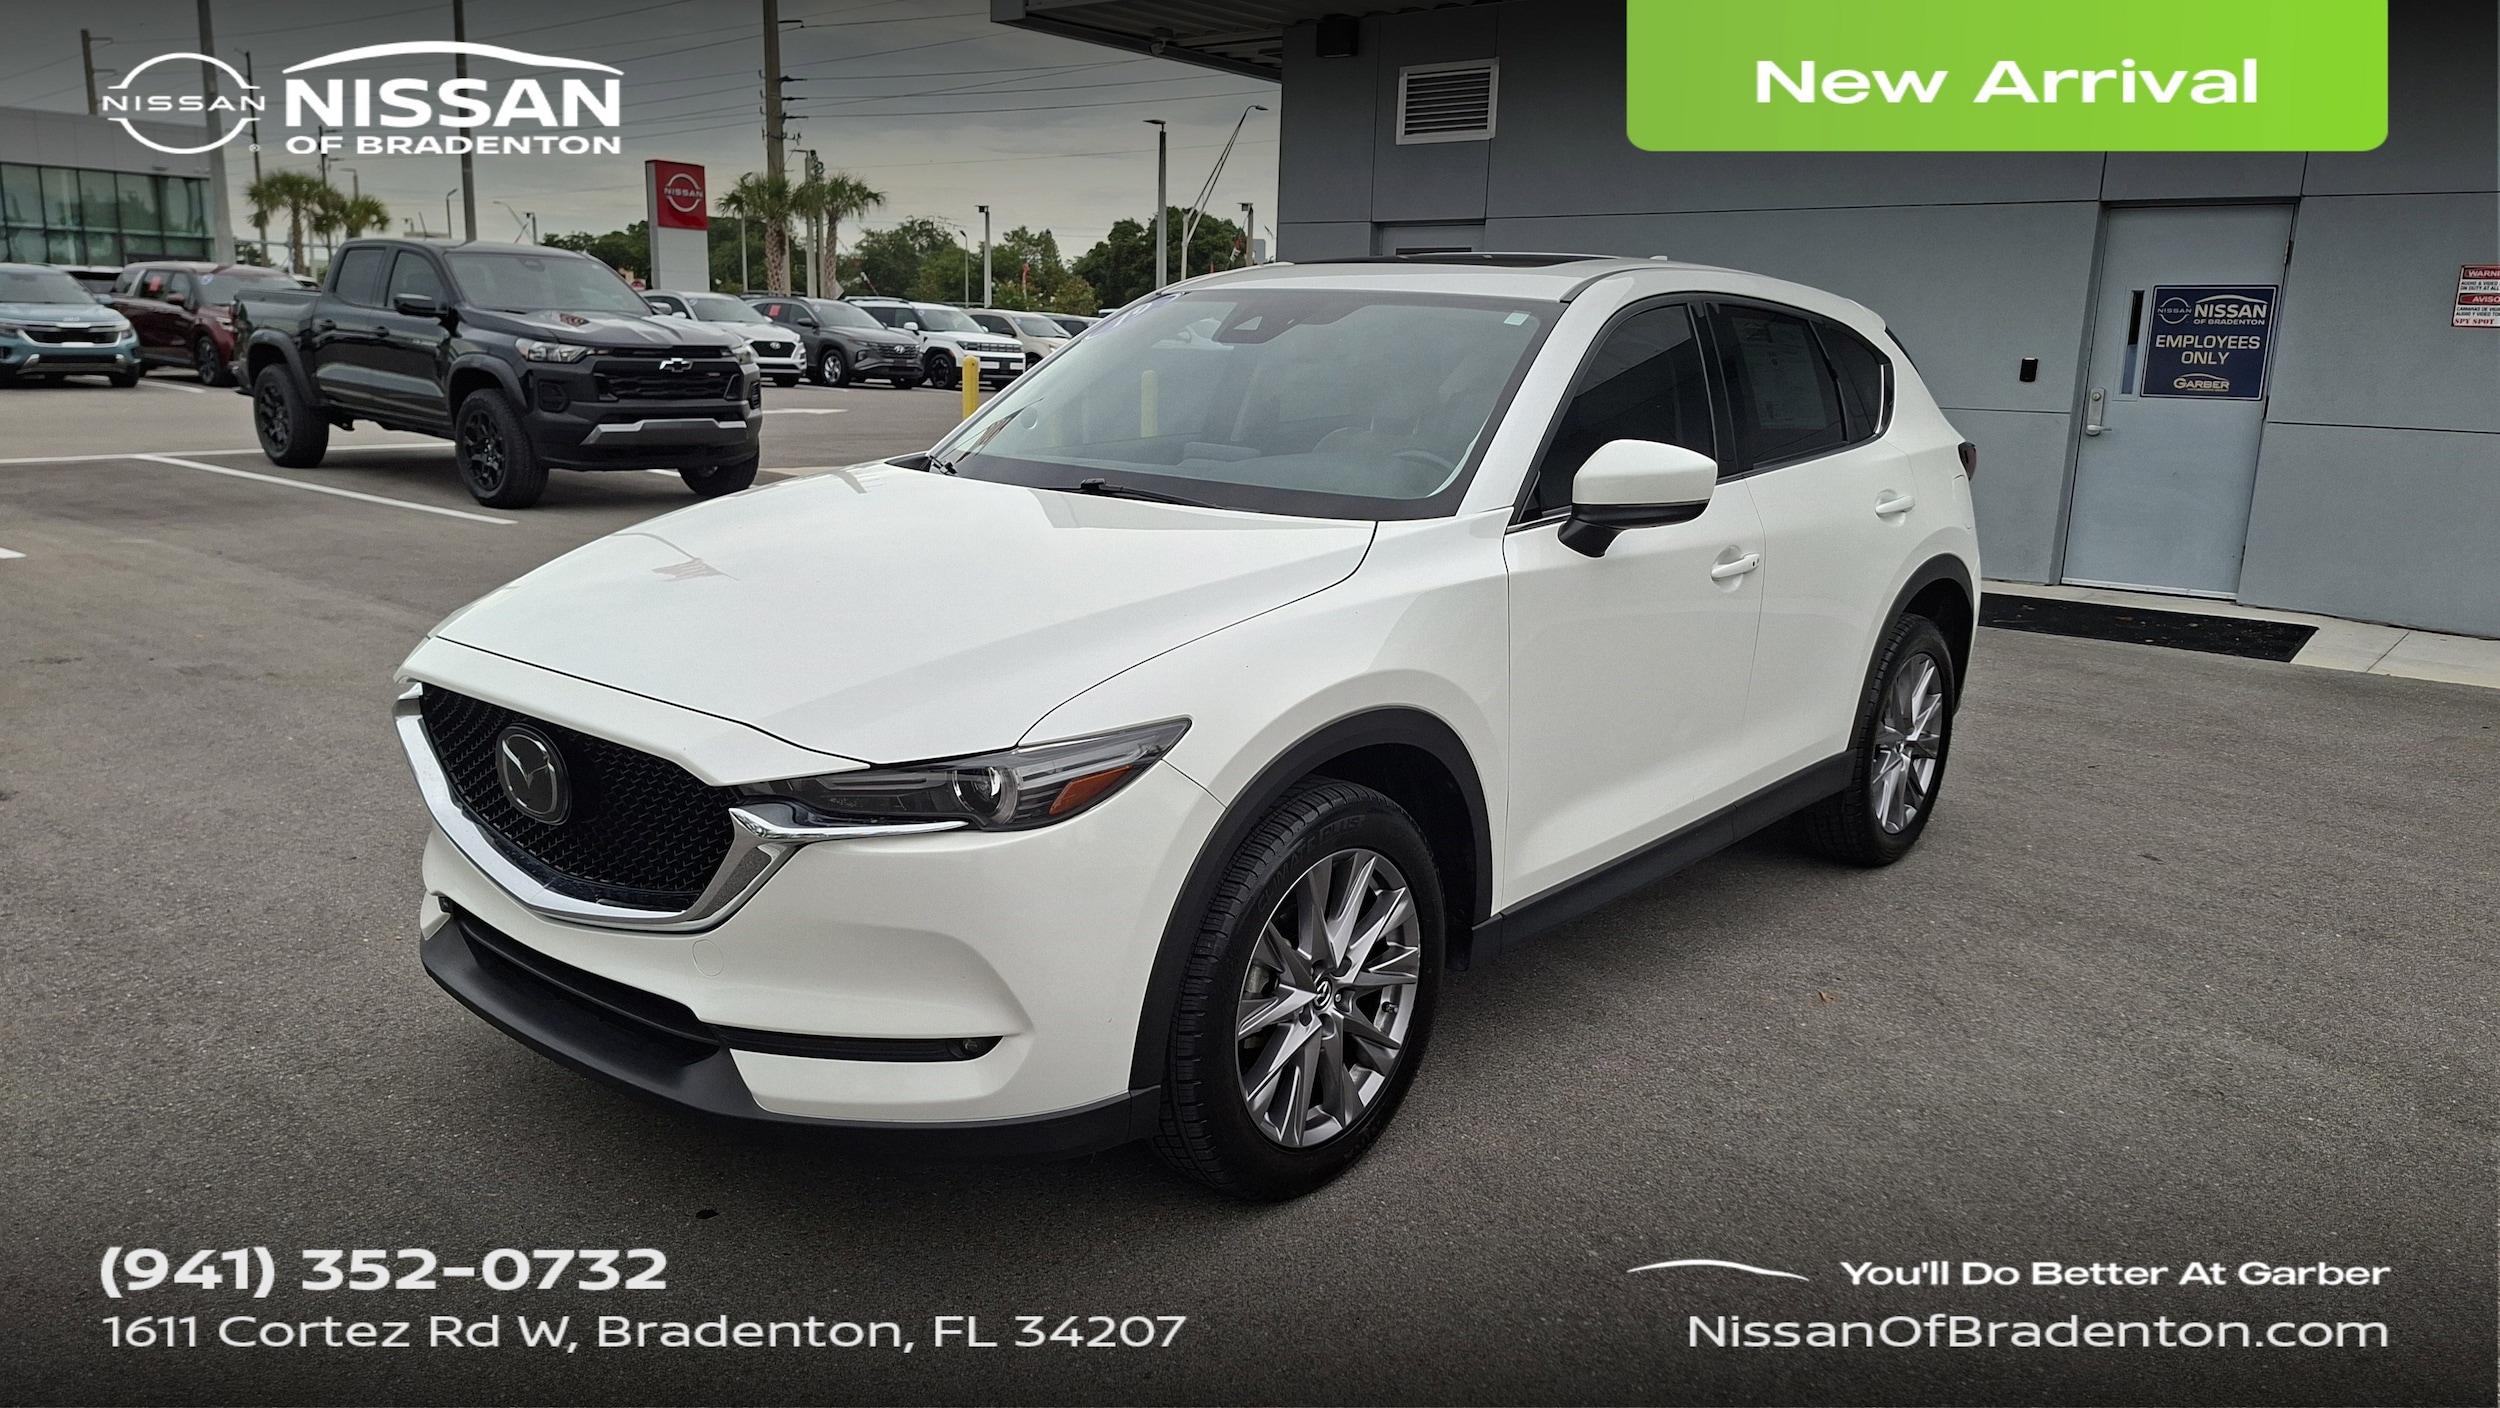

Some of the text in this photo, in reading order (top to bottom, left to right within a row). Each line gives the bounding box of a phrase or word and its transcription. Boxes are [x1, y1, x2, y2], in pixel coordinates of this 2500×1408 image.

[664, 187, 703, 198] NISSAN
[2194, 304, 2267, 318] NISSAN
[2155, 334, 2261, 349] EMPLOYEES
[2181, 351, 2230, 365] ONLY
[2173, 378, 2230, 389] GARBER
